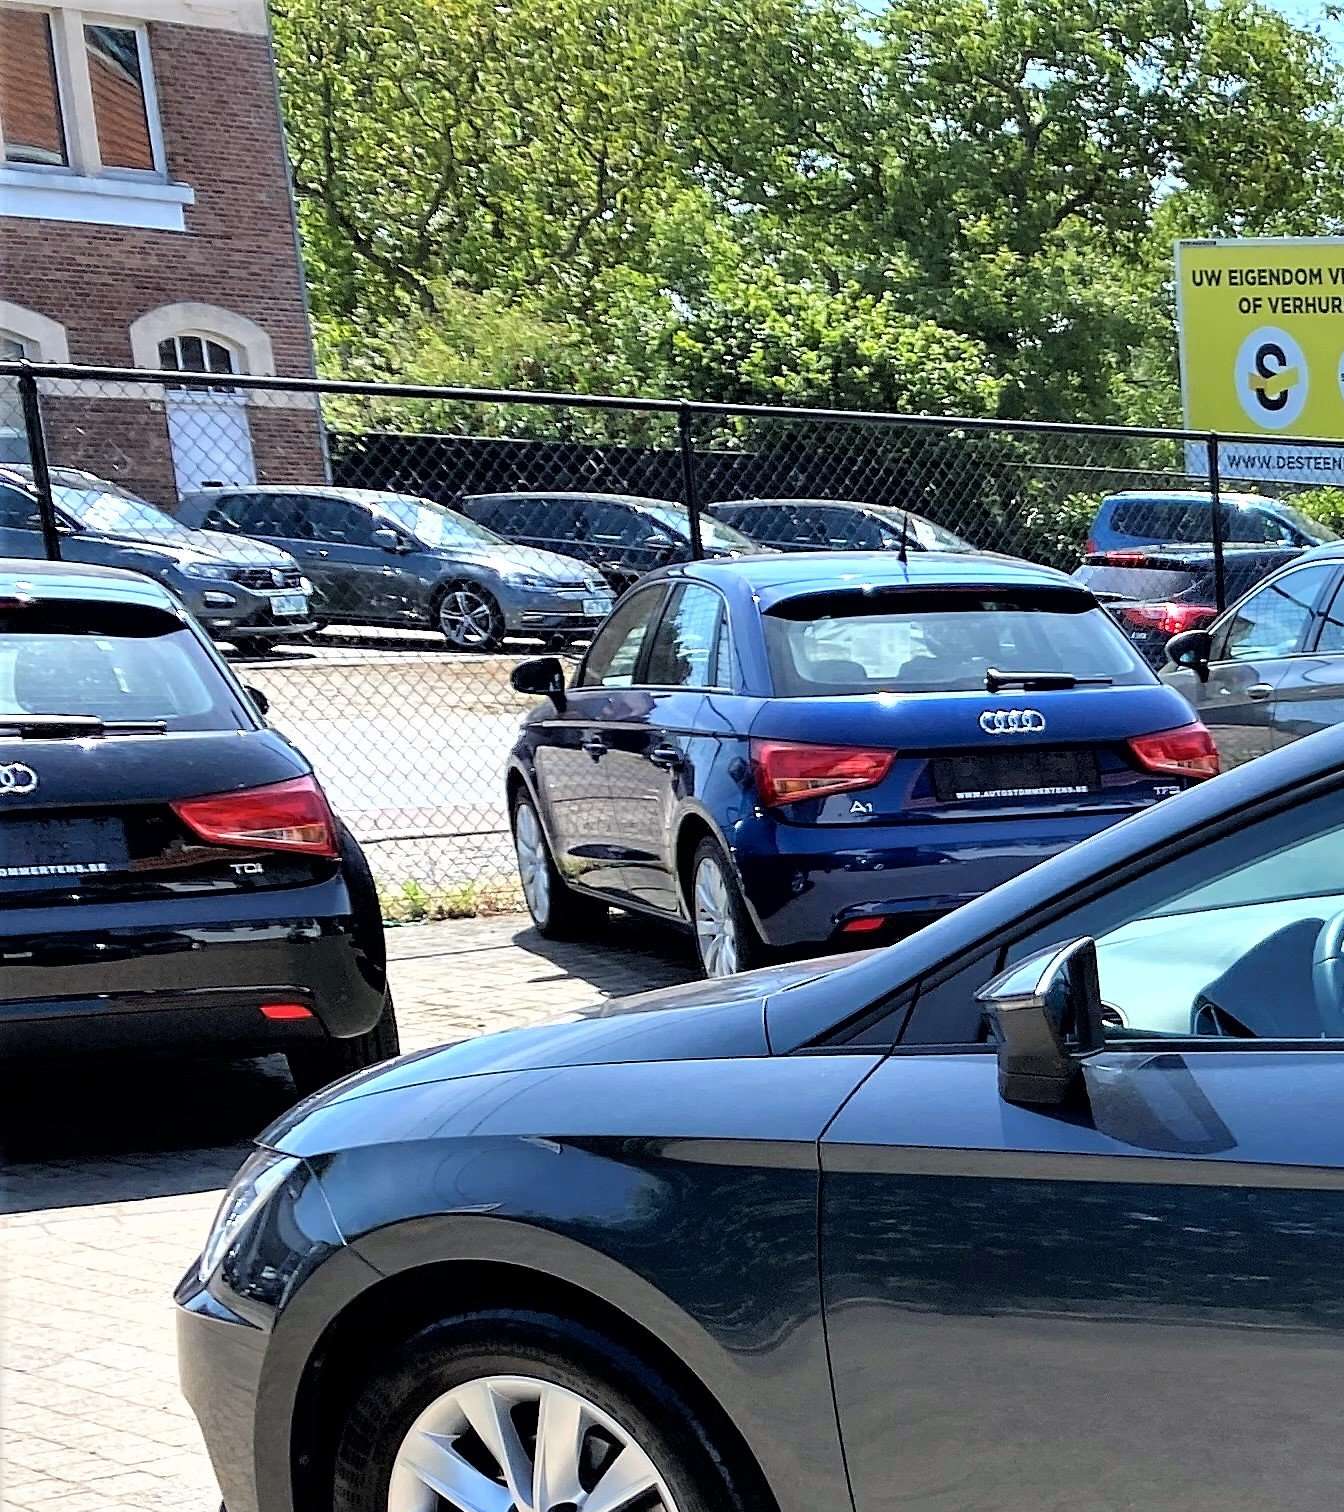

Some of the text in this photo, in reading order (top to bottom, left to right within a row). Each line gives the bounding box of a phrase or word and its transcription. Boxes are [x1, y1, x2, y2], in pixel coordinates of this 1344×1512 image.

[1191, 269, 1223, 287] UW
[1228, 268, 1323, 287] EIGENDOM
[1238, 297, 1263, 314] OF
[849, 800, 873, 813] A1
